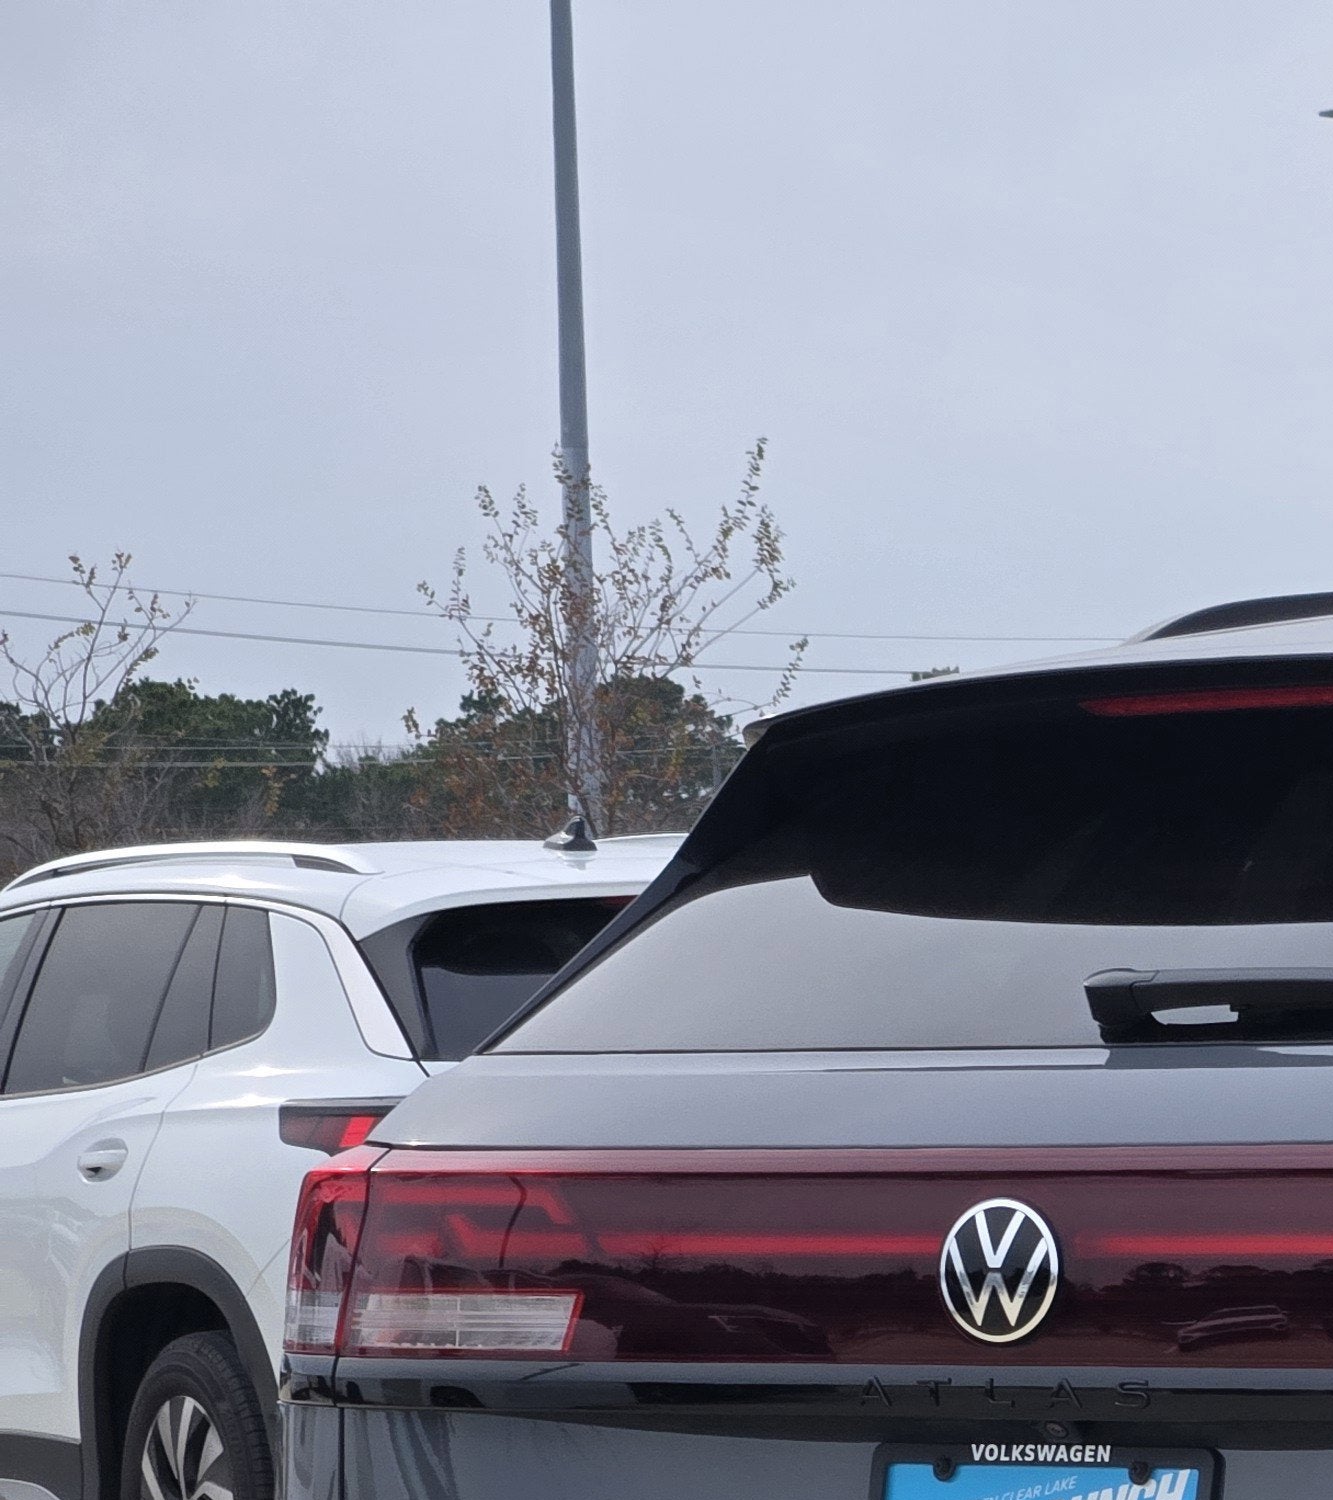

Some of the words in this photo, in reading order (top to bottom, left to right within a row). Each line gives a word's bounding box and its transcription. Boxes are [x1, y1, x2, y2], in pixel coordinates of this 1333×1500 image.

[860, 1375, 1152, 1409] ATLAS
[971, 1444, 1112, 1463] VOLKSWAGEN
[1044, 1475, 1079, 1496] LAKE
